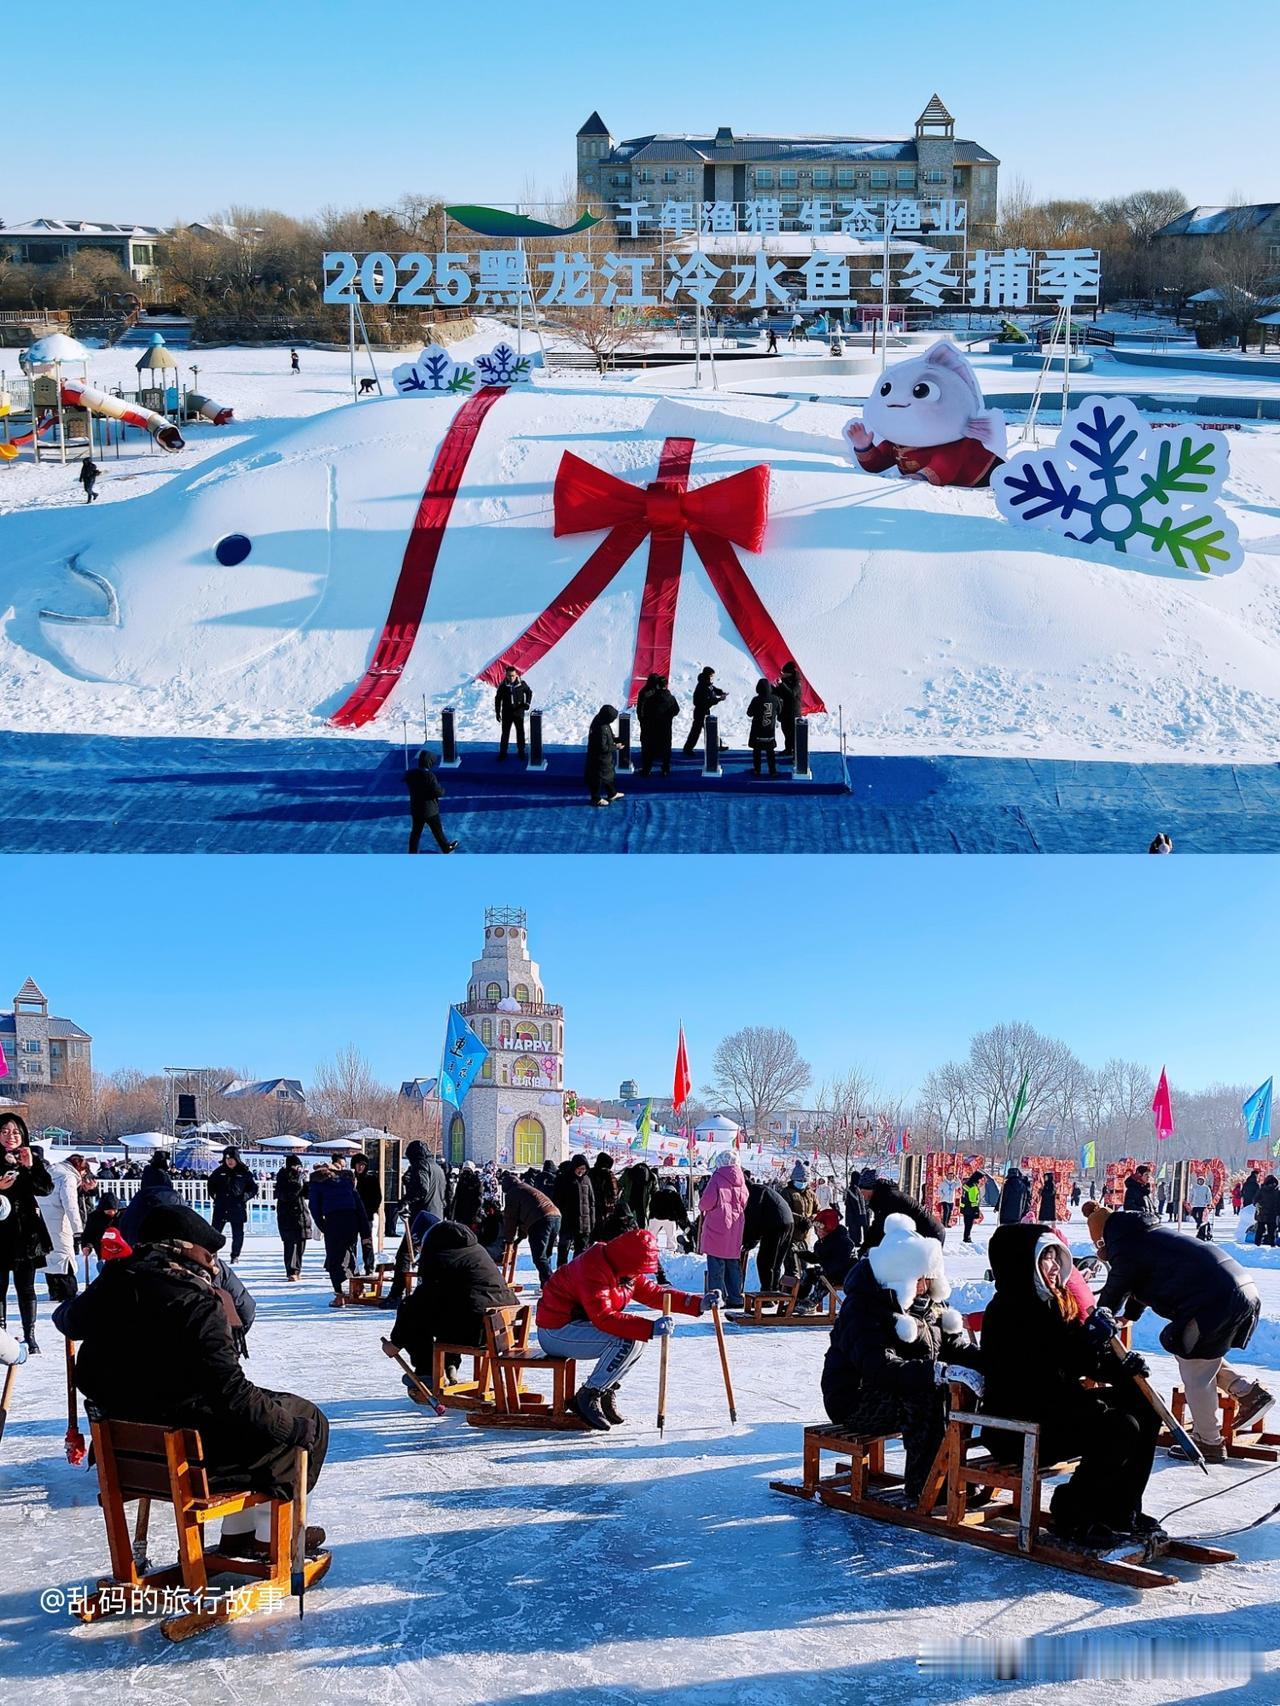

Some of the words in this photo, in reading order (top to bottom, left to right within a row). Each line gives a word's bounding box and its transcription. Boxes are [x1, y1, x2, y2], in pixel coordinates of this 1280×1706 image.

[616, 200, 783, 237] 千年渔猎
[799, 199, 965, 236] 生态渔业
[762, 703, 772, 726] FILA
[503, 1037, 551, 1052] HAPPY
